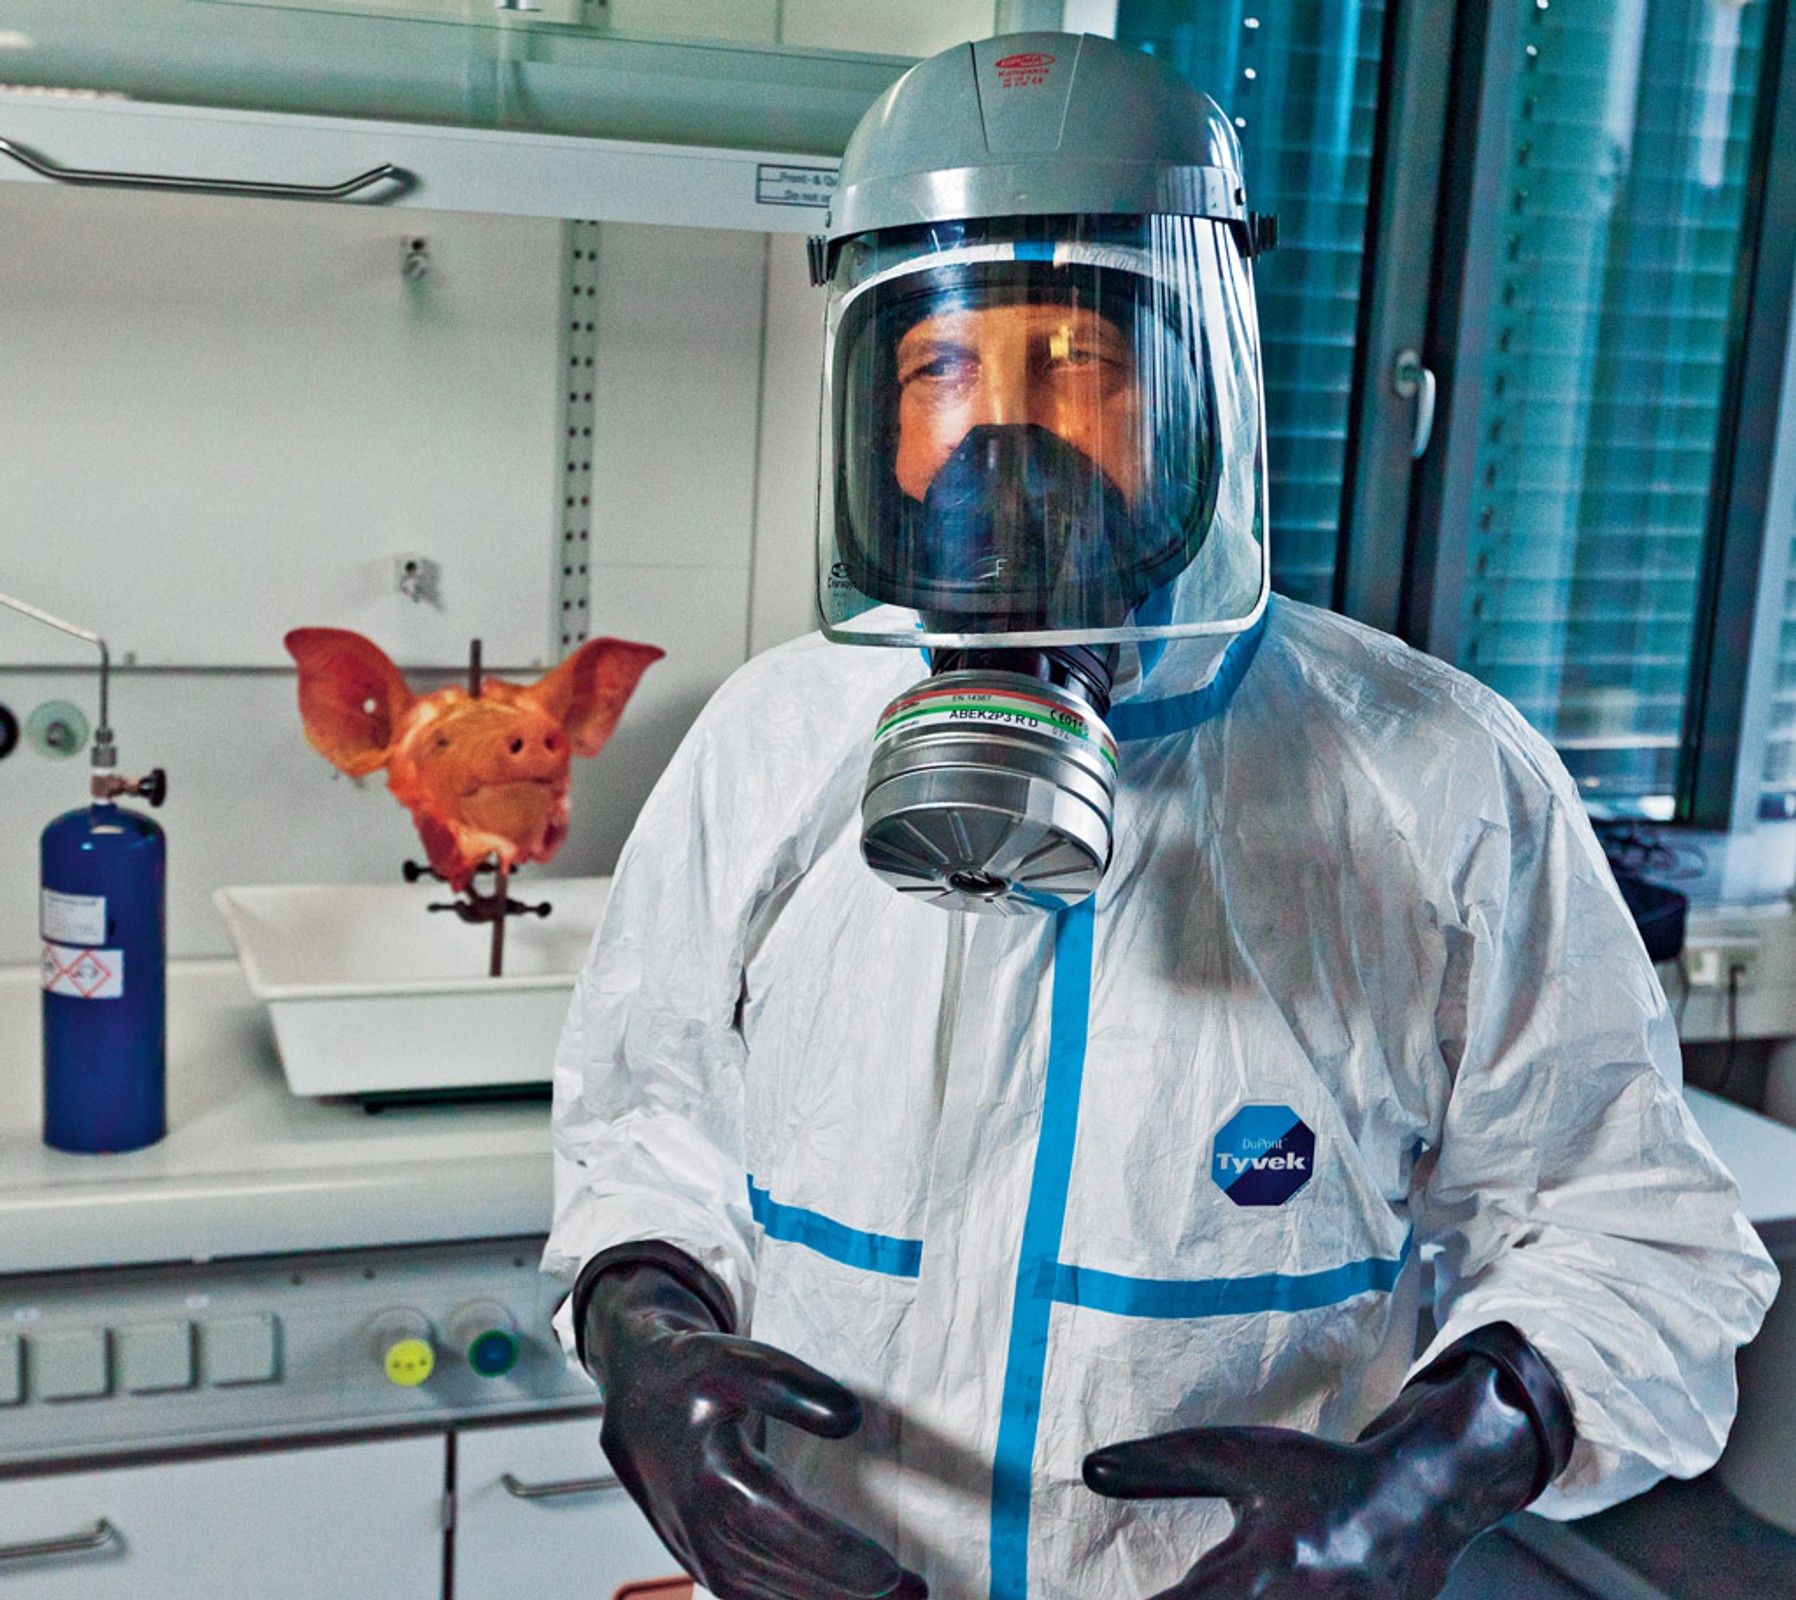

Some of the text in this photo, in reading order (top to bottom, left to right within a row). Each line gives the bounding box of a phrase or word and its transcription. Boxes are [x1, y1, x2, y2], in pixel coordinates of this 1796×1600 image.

[952, 694, 965, 702] EN
[949, 709, 1039, 728] ABEK2P3 R D
[1242, 1137, 1283, 1150] DuPont
[1216, 1152, 1306, 1174] Tyvek
